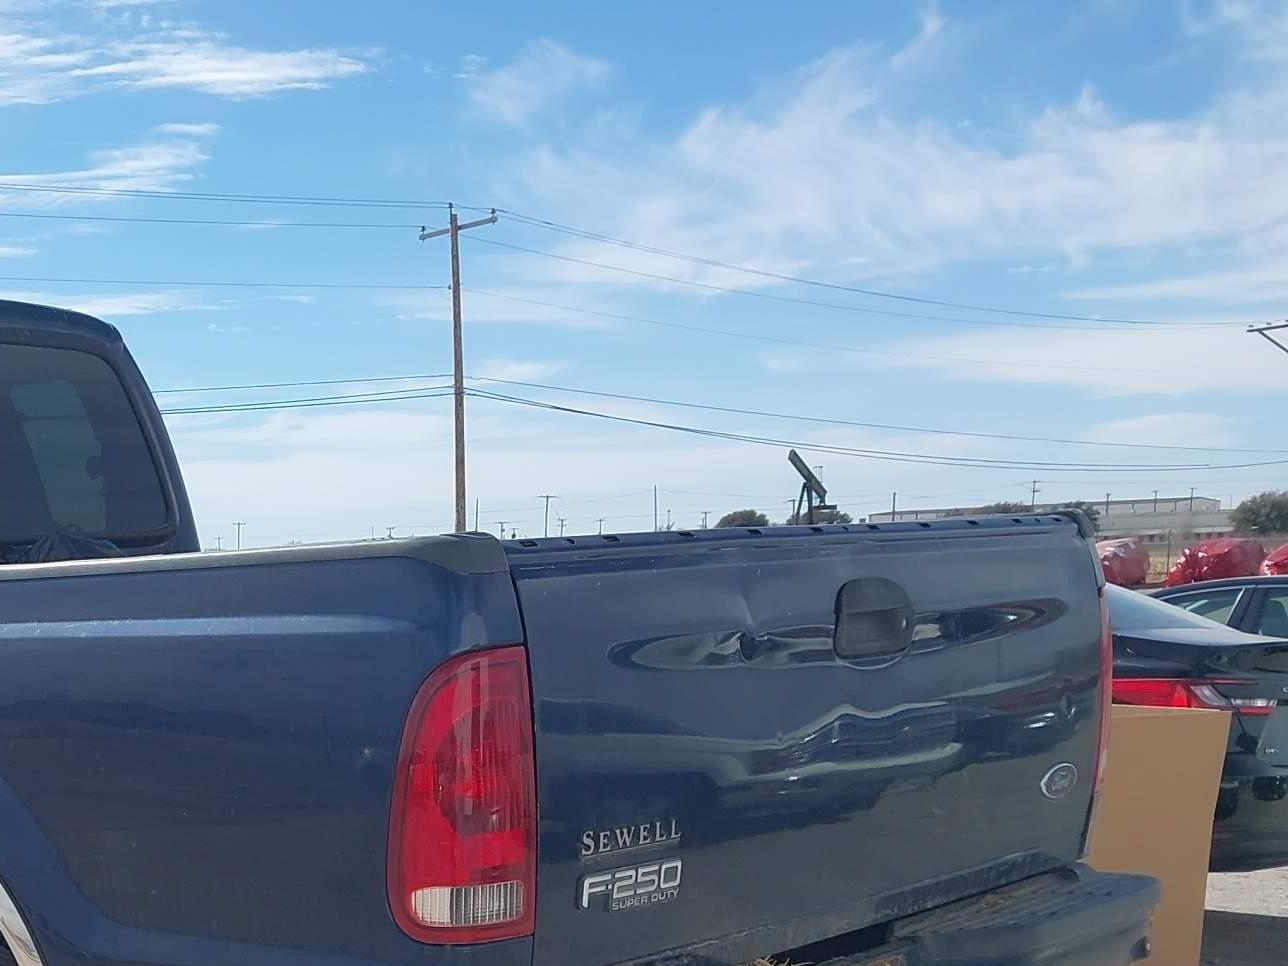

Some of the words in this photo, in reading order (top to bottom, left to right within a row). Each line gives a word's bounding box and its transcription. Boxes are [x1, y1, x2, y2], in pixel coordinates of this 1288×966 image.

[581, 818, 682, 856] SEWELL
[612, 895, 648, 910] SUPER
[651, 887, 679, 902] DUTY
